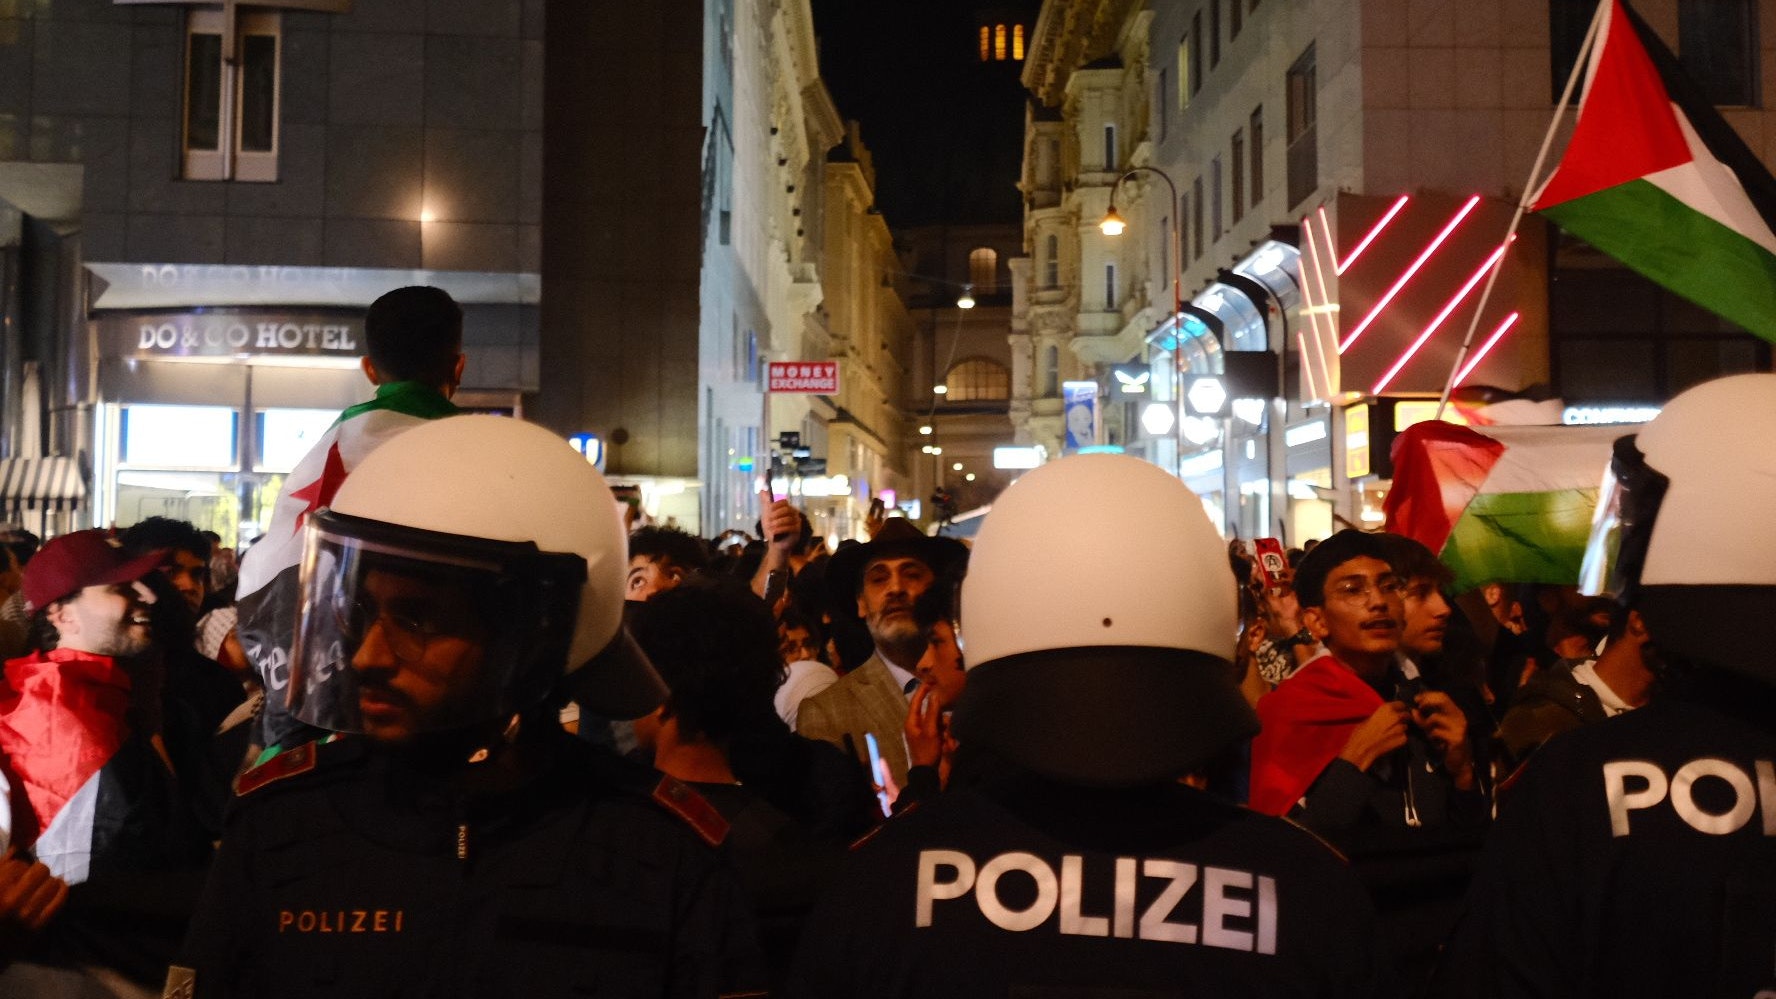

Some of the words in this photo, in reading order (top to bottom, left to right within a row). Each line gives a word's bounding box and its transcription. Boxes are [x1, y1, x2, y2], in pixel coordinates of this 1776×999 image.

[138, 323, 177, 348] DO
[181, 325, 199, 348] &
[203, 323, 249, 348] CO
[255, 322, 356, 350] HOTEL
[771, 365, 835, 378] MONEY
[771, 379, 834, 390] EXCHANGE
[457, 825, 466, 859] POLIZEI
[915, 850, 1278, 955] POLIZEI
[279, 911, 403, 932] POLIZEI
